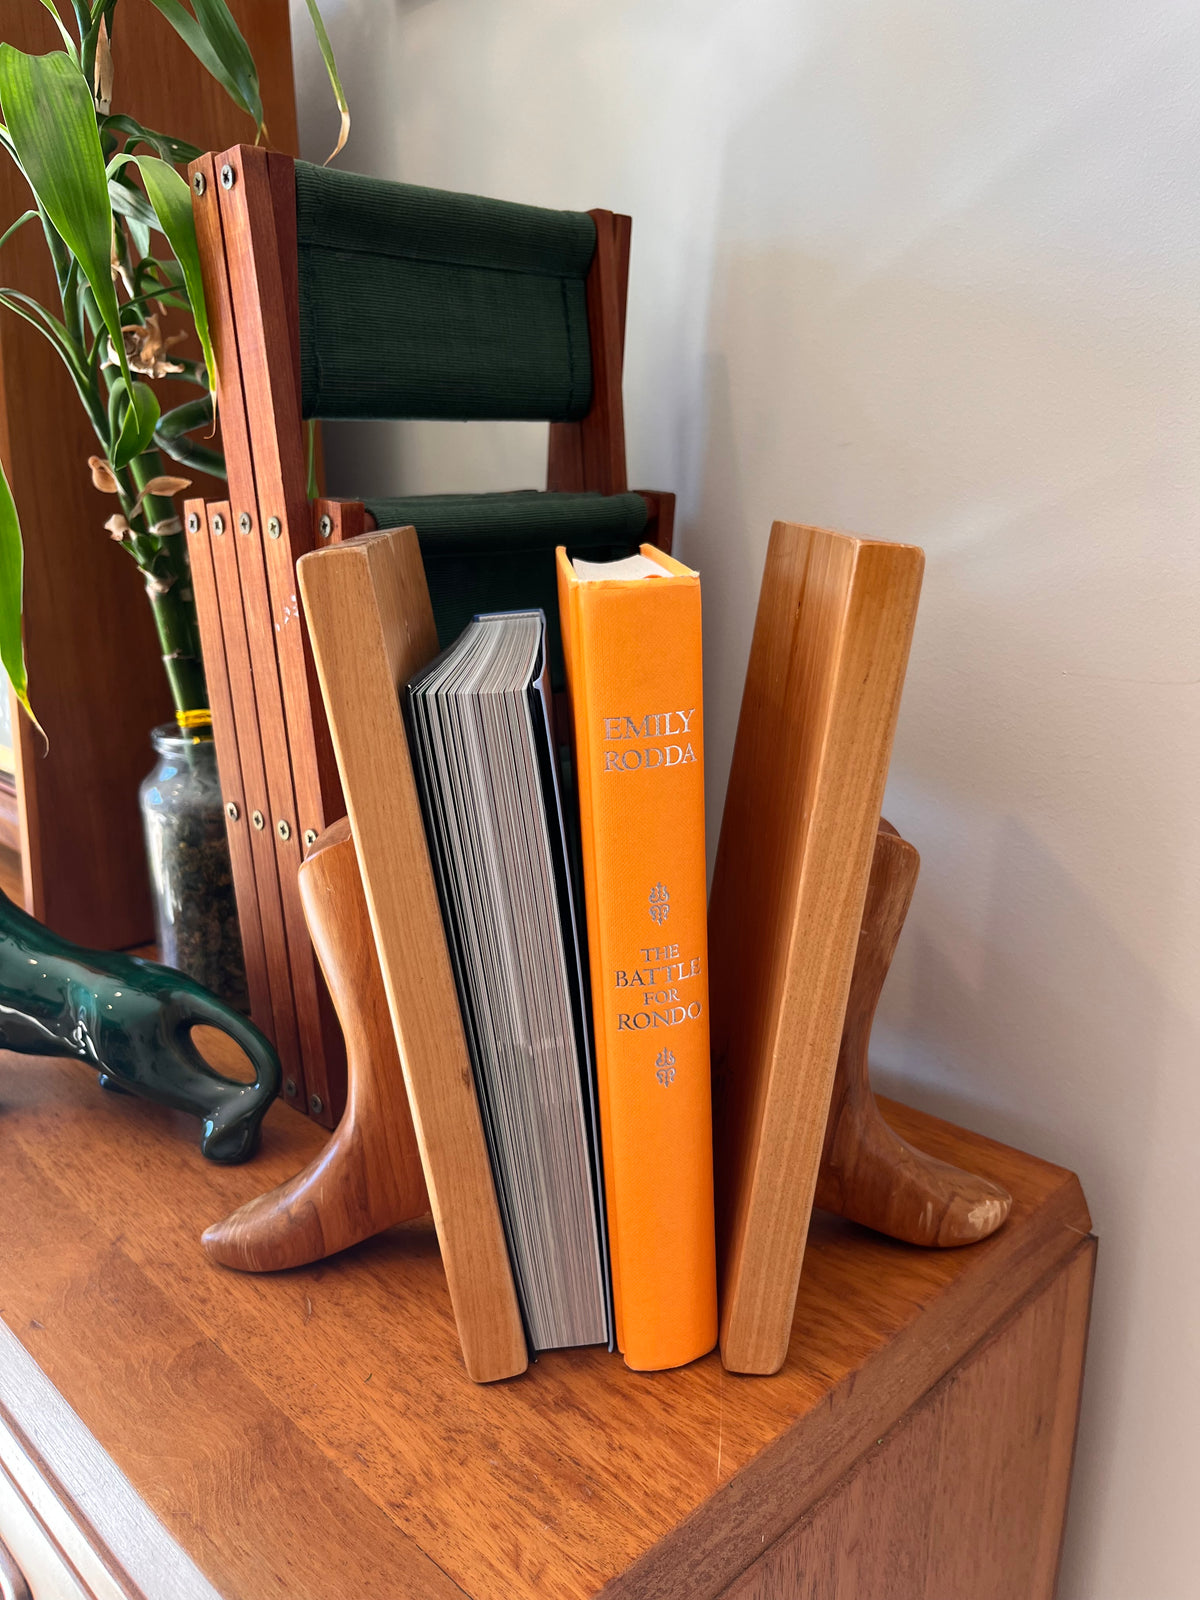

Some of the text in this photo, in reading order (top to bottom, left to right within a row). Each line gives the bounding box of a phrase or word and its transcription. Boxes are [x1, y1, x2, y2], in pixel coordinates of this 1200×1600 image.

[603, 708, 696, 741] EMILY
[603, 742, 697, 772] RODDA
[640, 943, 679, 963] THE
[614, 957, 701, 989] BATTLE
[643, 988, 680, 1006] FOR
[617, 1001, 702, 1032] RONDO
